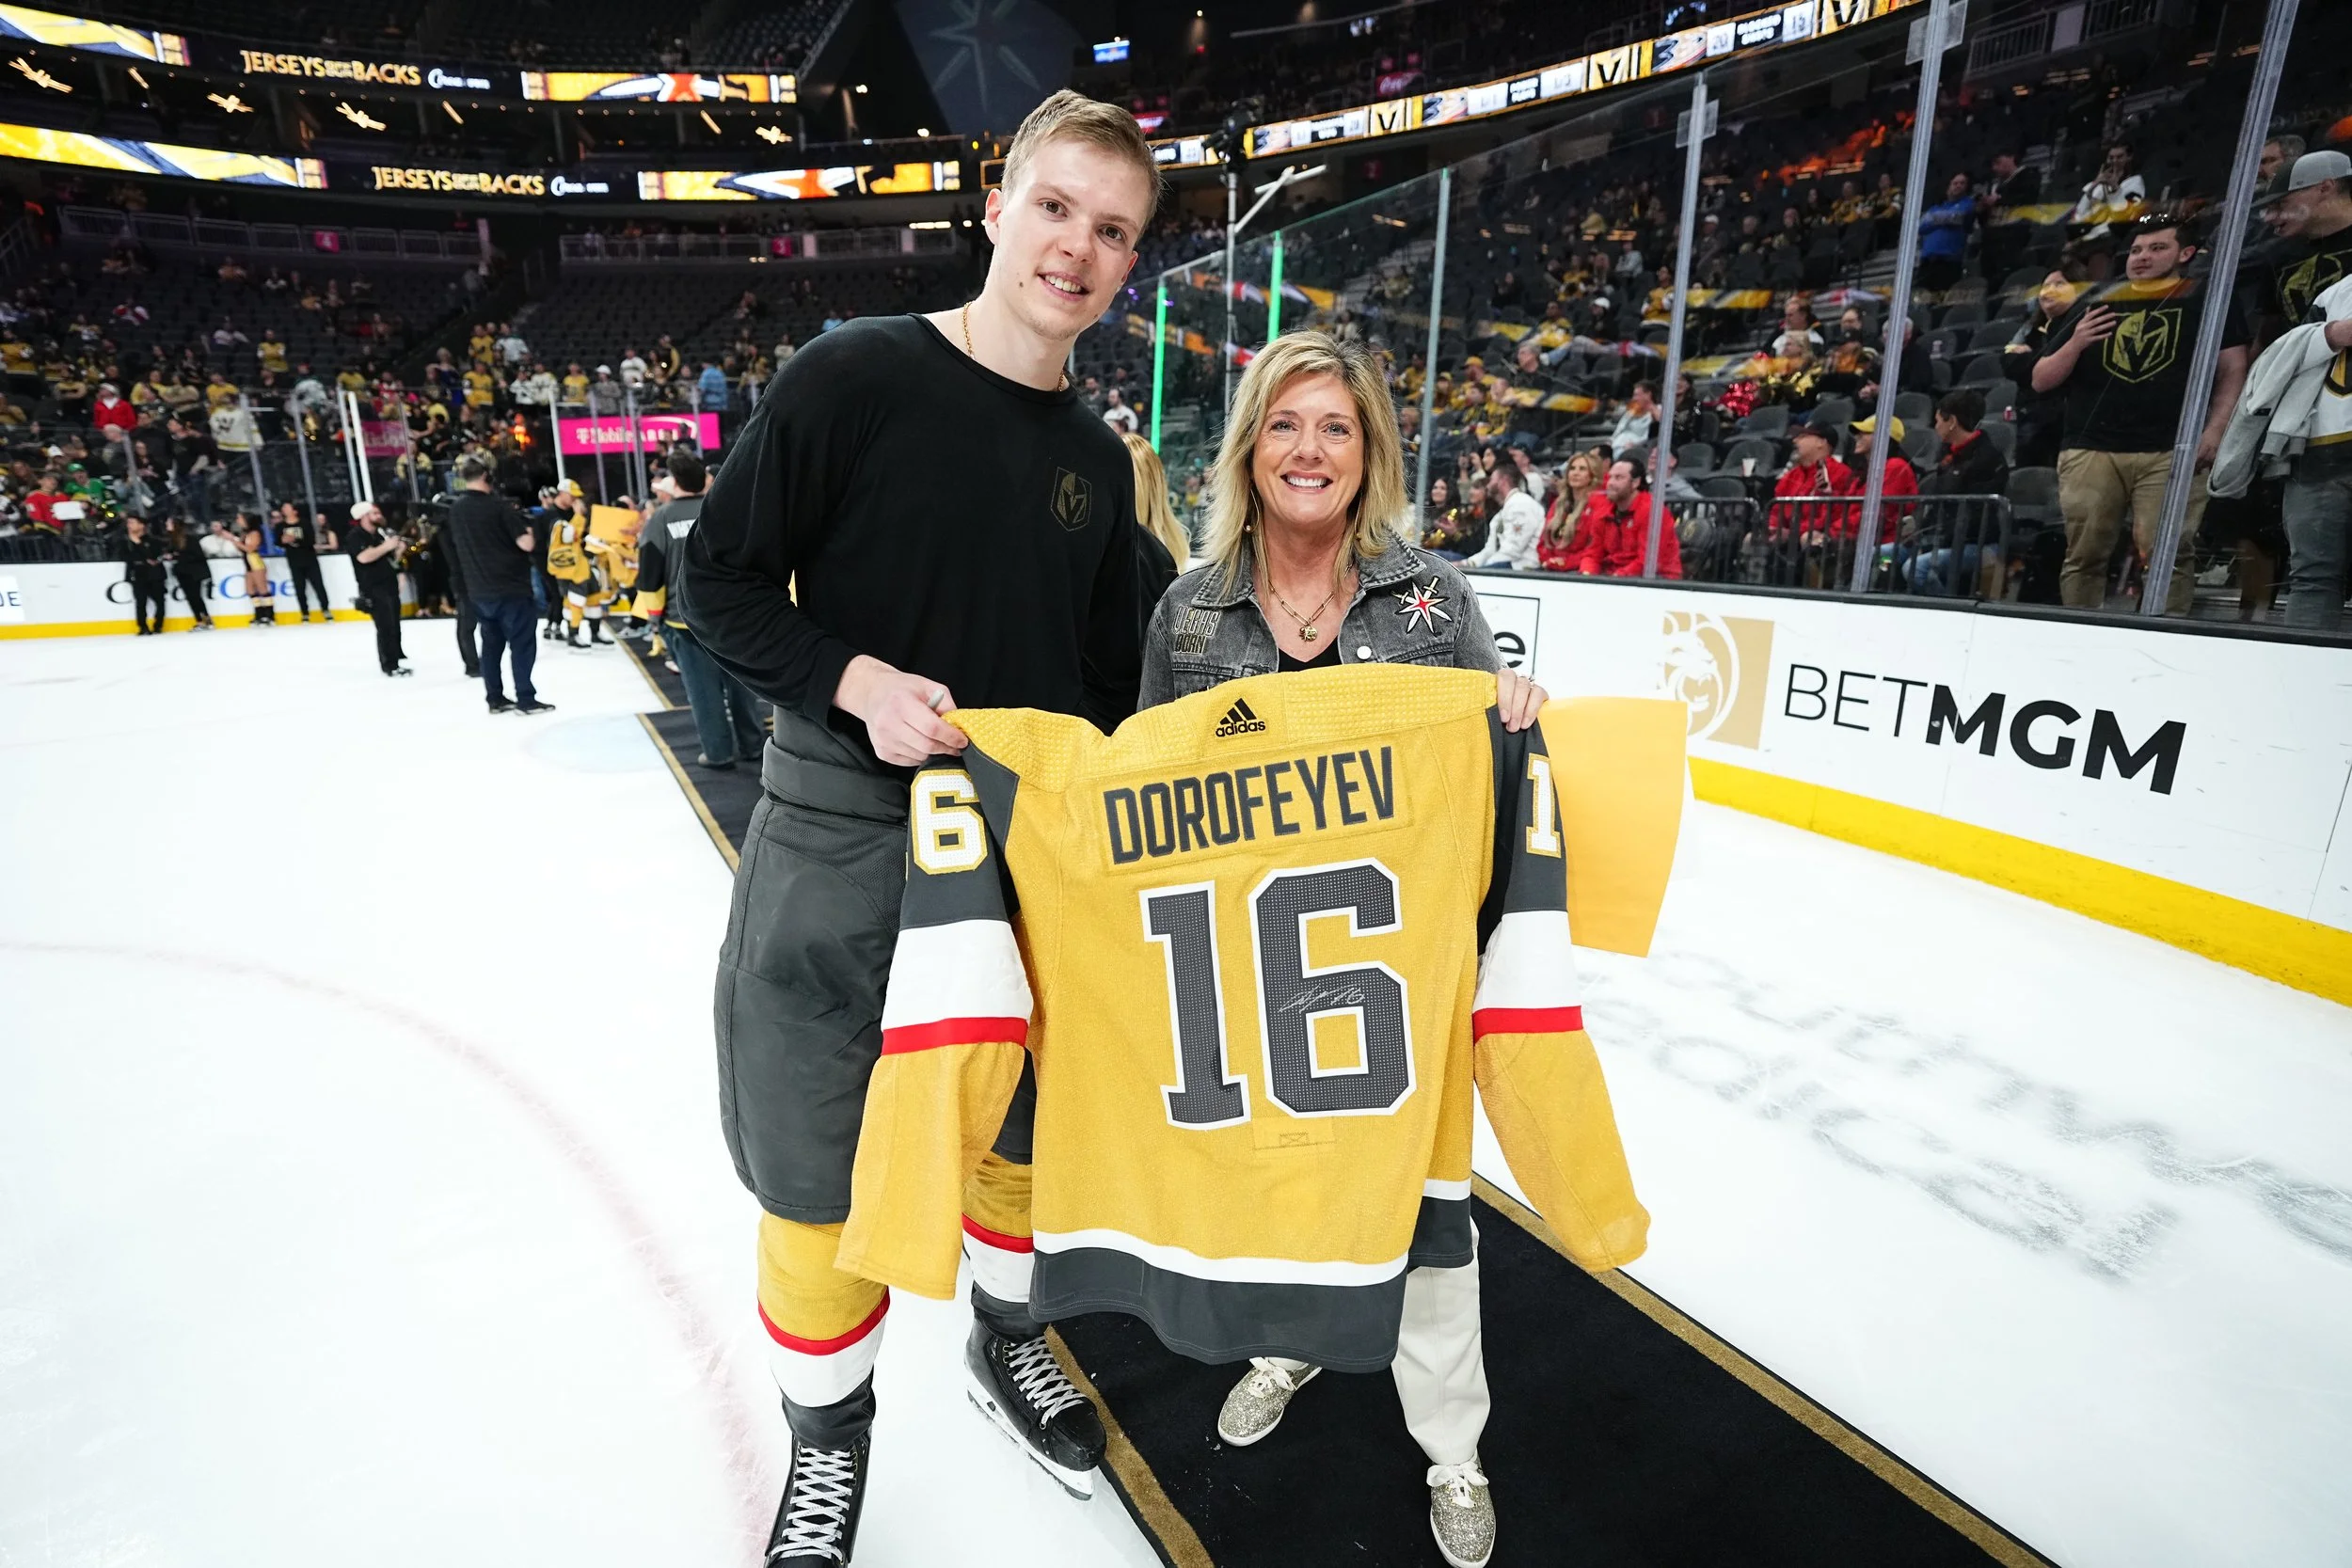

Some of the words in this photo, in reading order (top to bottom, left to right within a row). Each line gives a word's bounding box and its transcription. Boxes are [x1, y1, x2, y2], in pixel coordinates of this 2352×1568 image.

[239, 49, 325, 78] JERSEYS
[351, 60, 421, 87] BACKS
[371, 166, 453, 192] JERSEYS
[478, 172, 545, 196] BACKS
[1172, 606, 1221, 637] VEGAS
[1173, 634, 1207, 654] BORN
[1215, 721, 1266, 737] adidas
[1784, 663, 2187, 796] BETMGM
[1103, 745, 1395, 864] DOROFEYEV
[1138, 857, 1418, 1132] 16
